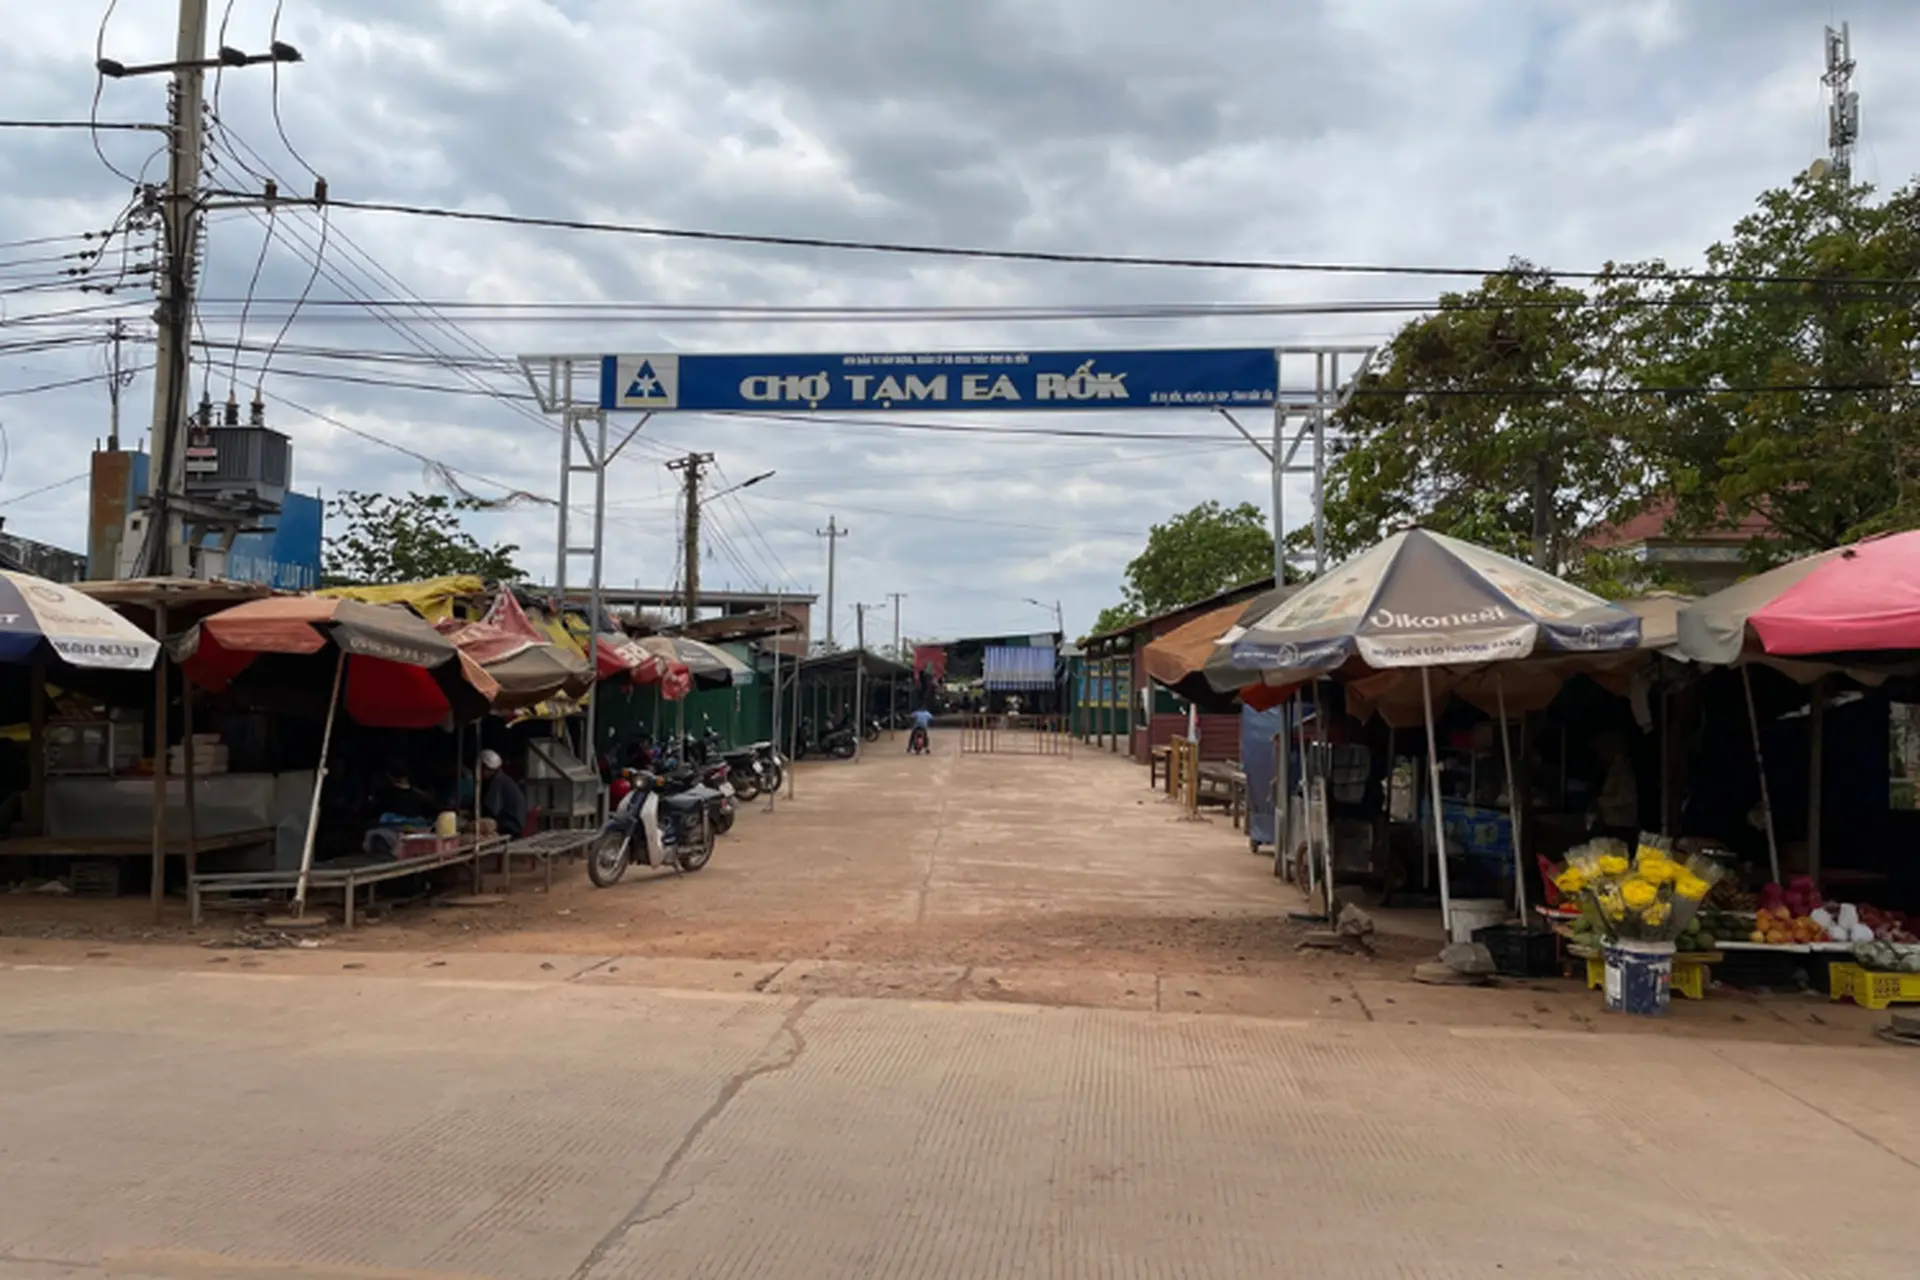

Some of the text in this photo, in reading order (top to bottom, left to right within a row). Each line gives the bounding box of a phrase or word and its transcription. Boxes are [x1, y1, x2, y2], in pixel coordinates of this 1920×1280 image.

[739, 370, 830, 410] CHỢ
[844, 374, 948, 409] TẠM
[961, 374, 1021, 401] EA
[1036, 359, 1129, 400] RỐK
